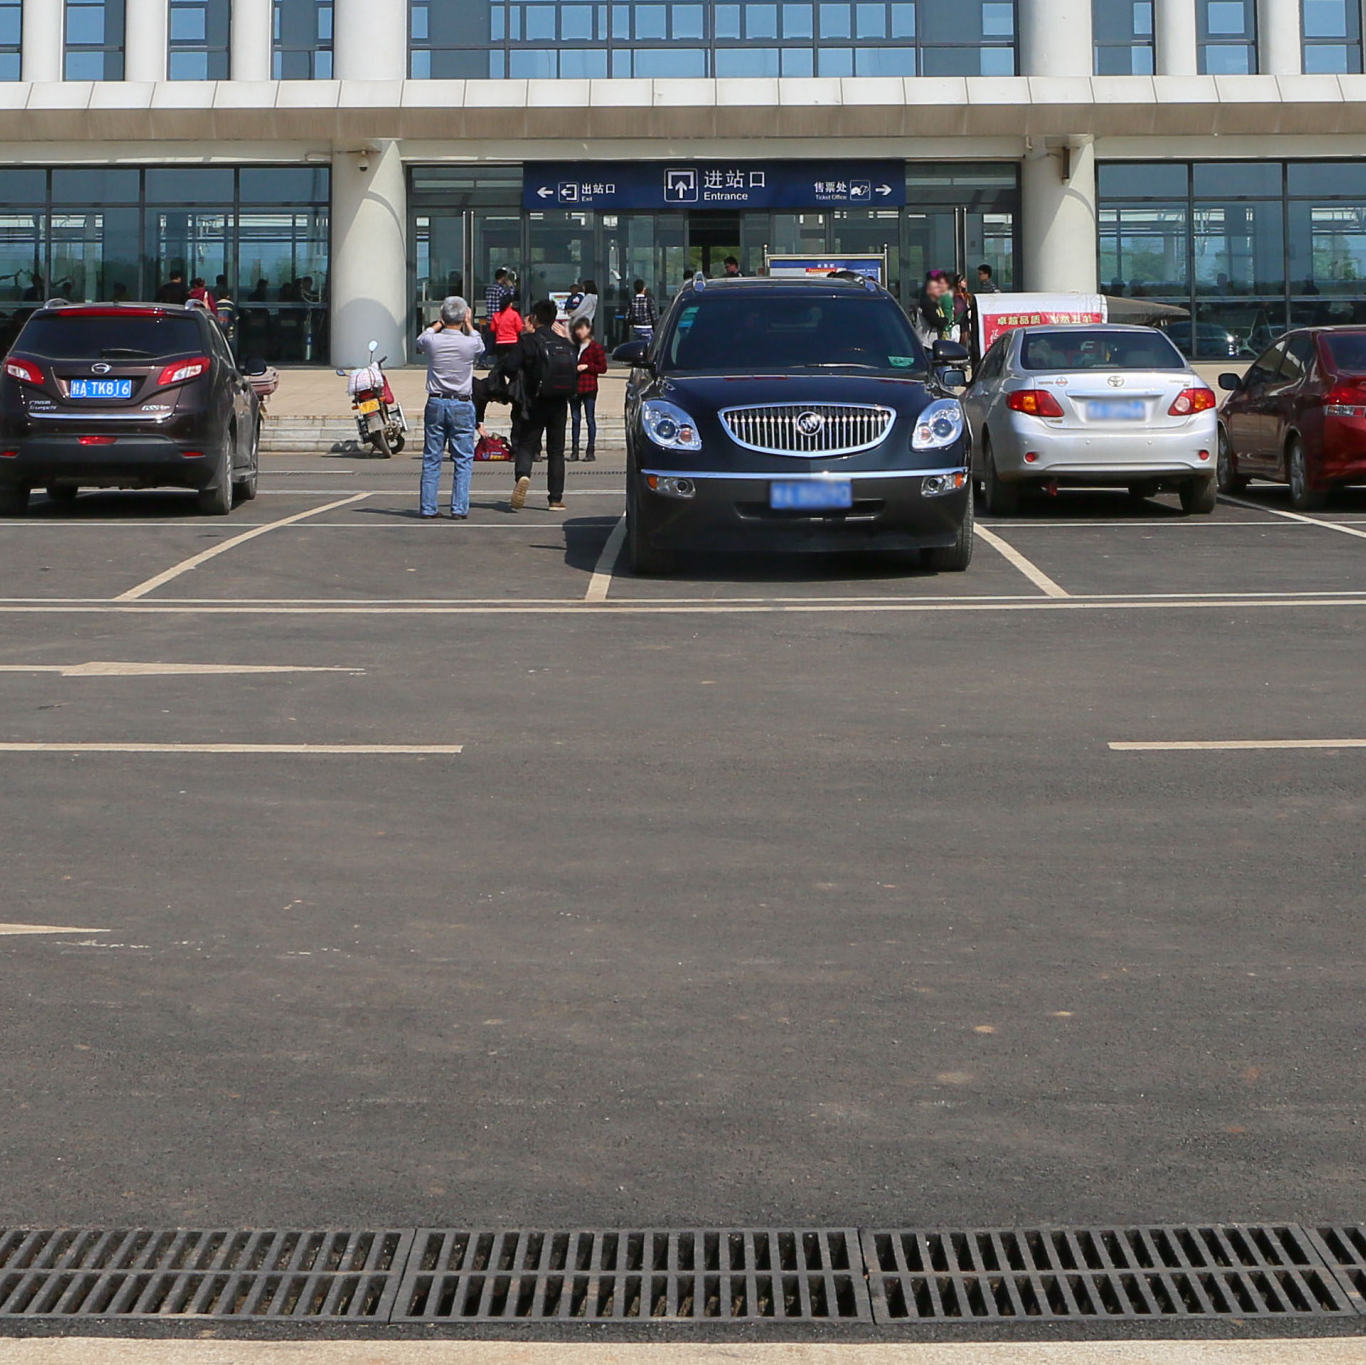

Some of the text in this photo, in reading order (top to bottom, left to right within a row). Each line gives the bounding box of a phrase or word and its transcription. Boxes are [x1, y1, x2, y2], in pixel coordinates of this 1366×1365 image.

[704, 169, 765, 189] 进站口
[581, 183, 616, 195] 出站口
[813, 181, 847, 193] 售票处
[704, 191, 748, 201] Entrance
